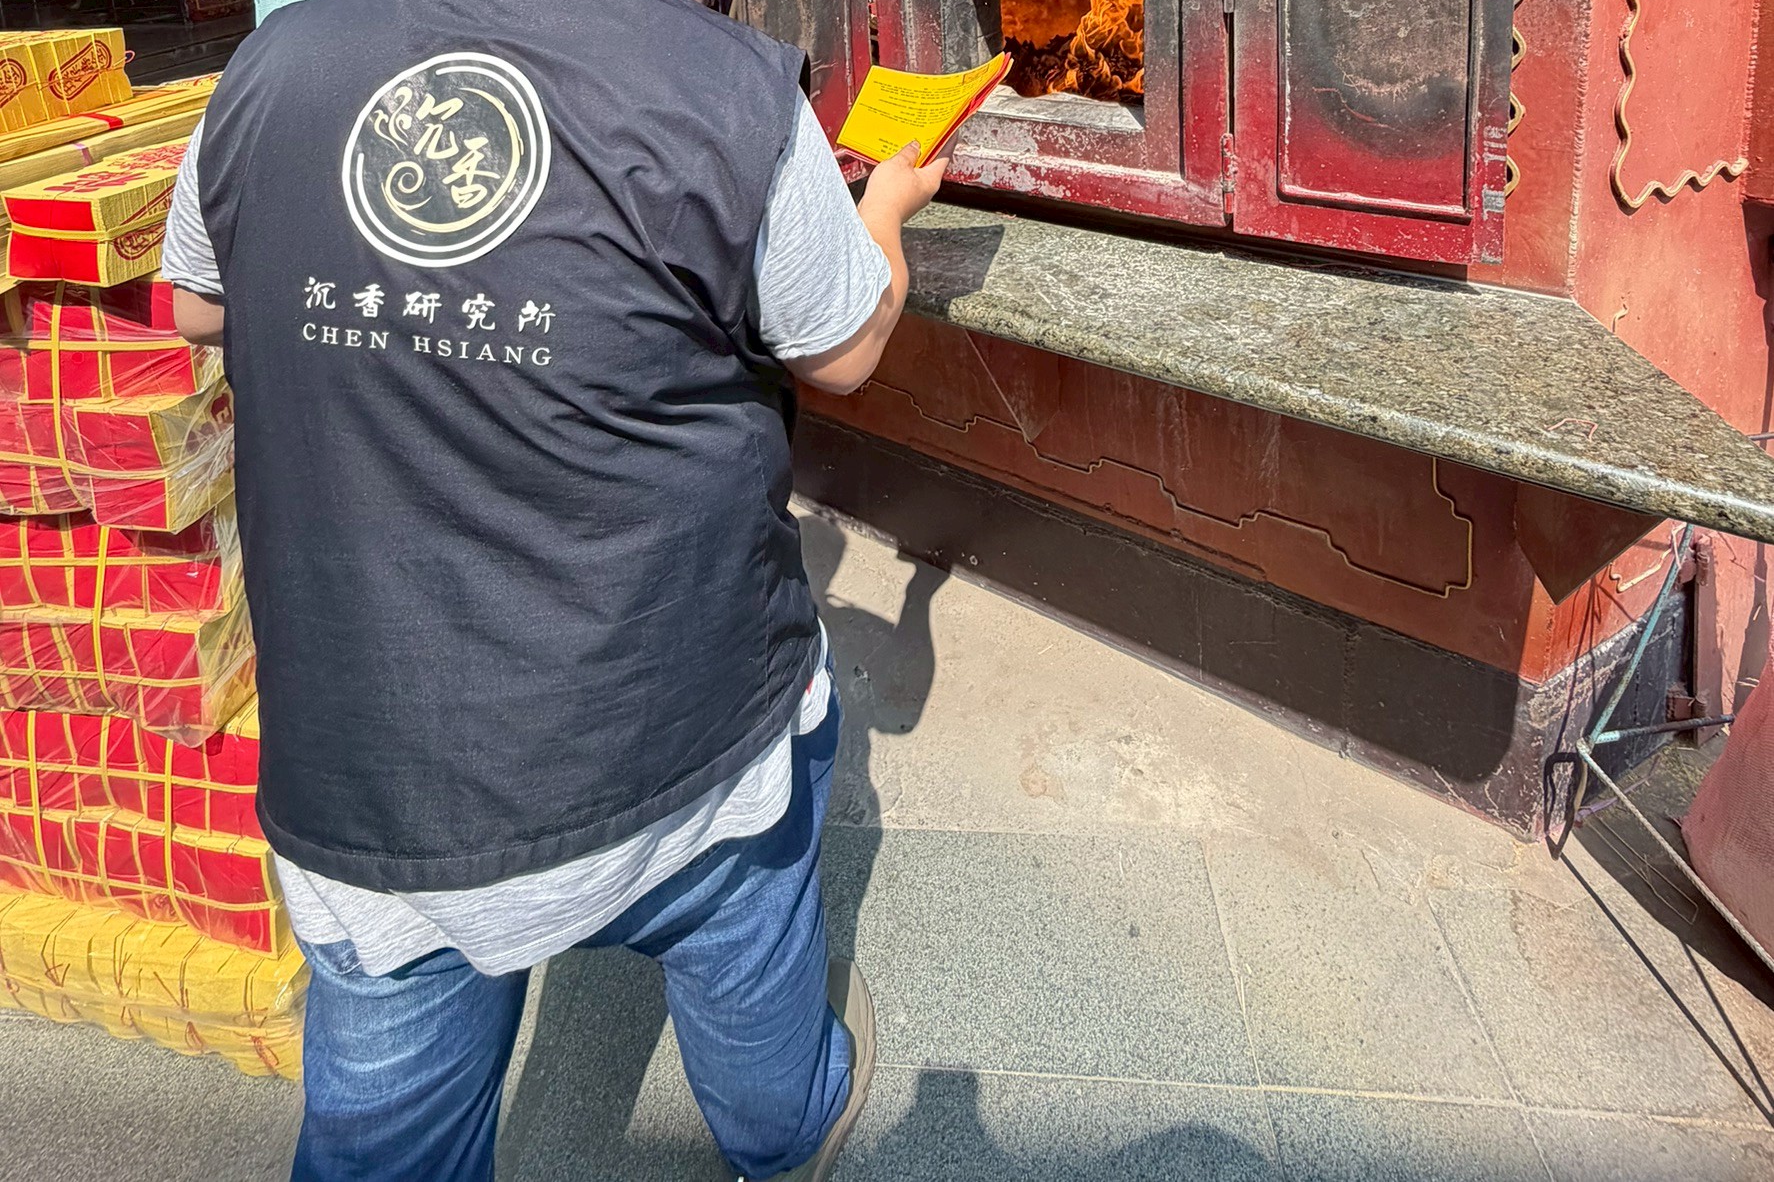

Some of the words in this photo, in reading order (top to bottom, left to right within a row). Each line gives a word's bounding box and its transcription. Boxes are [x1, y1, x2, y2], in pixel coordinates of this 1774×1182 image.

[303, 277, 556, 333] 沉香研究所
[301, 322, 390, 351] CHEN
[412, 335, 553, 367] HSIANG
